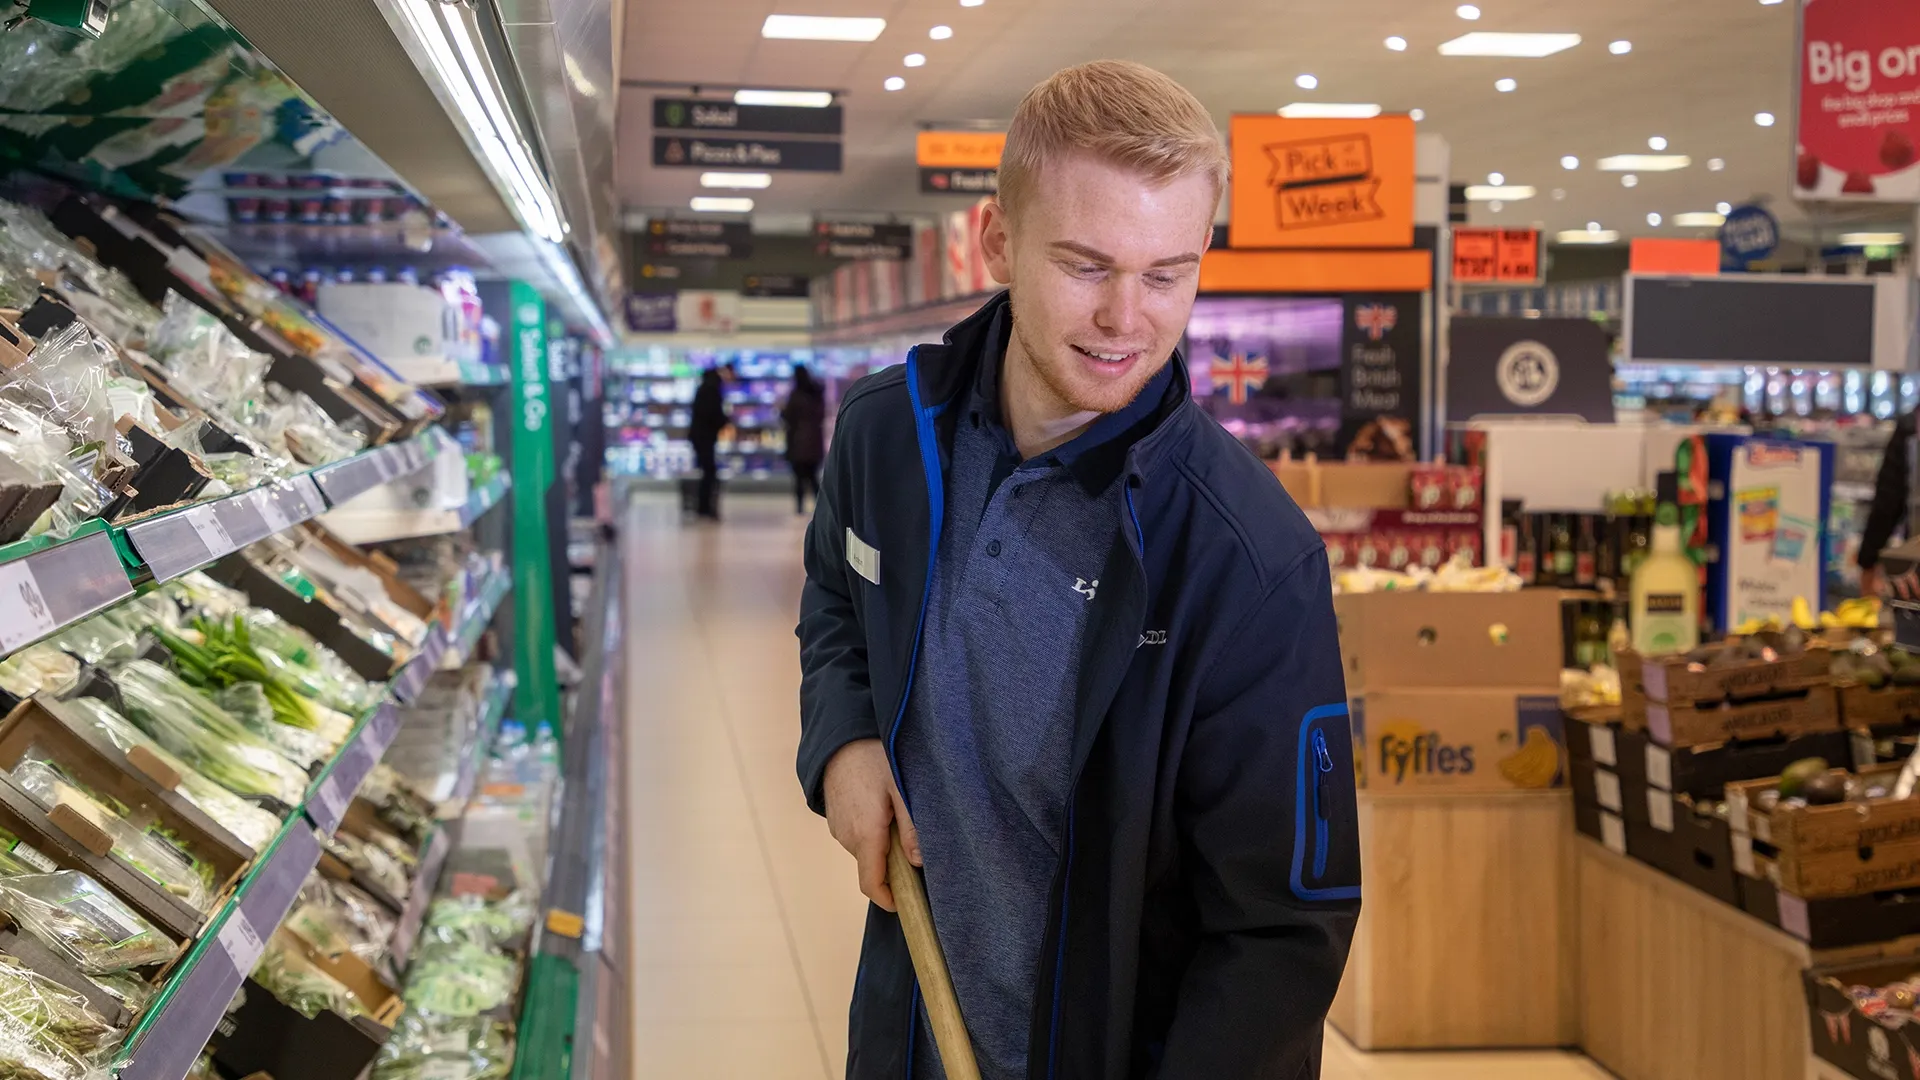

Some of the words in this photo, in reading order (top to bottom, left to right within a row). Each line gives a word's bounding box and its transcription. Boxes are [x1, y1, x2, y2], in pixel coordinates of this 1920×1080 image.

[1808, 41, 1871, 92] Big
[692, 105, 737, 126] Salad
[1286, 147, 1337, 175] Pick
[1287, 188, 1363, 217] Week
[1380, 731, 1475, 785] fyffes
